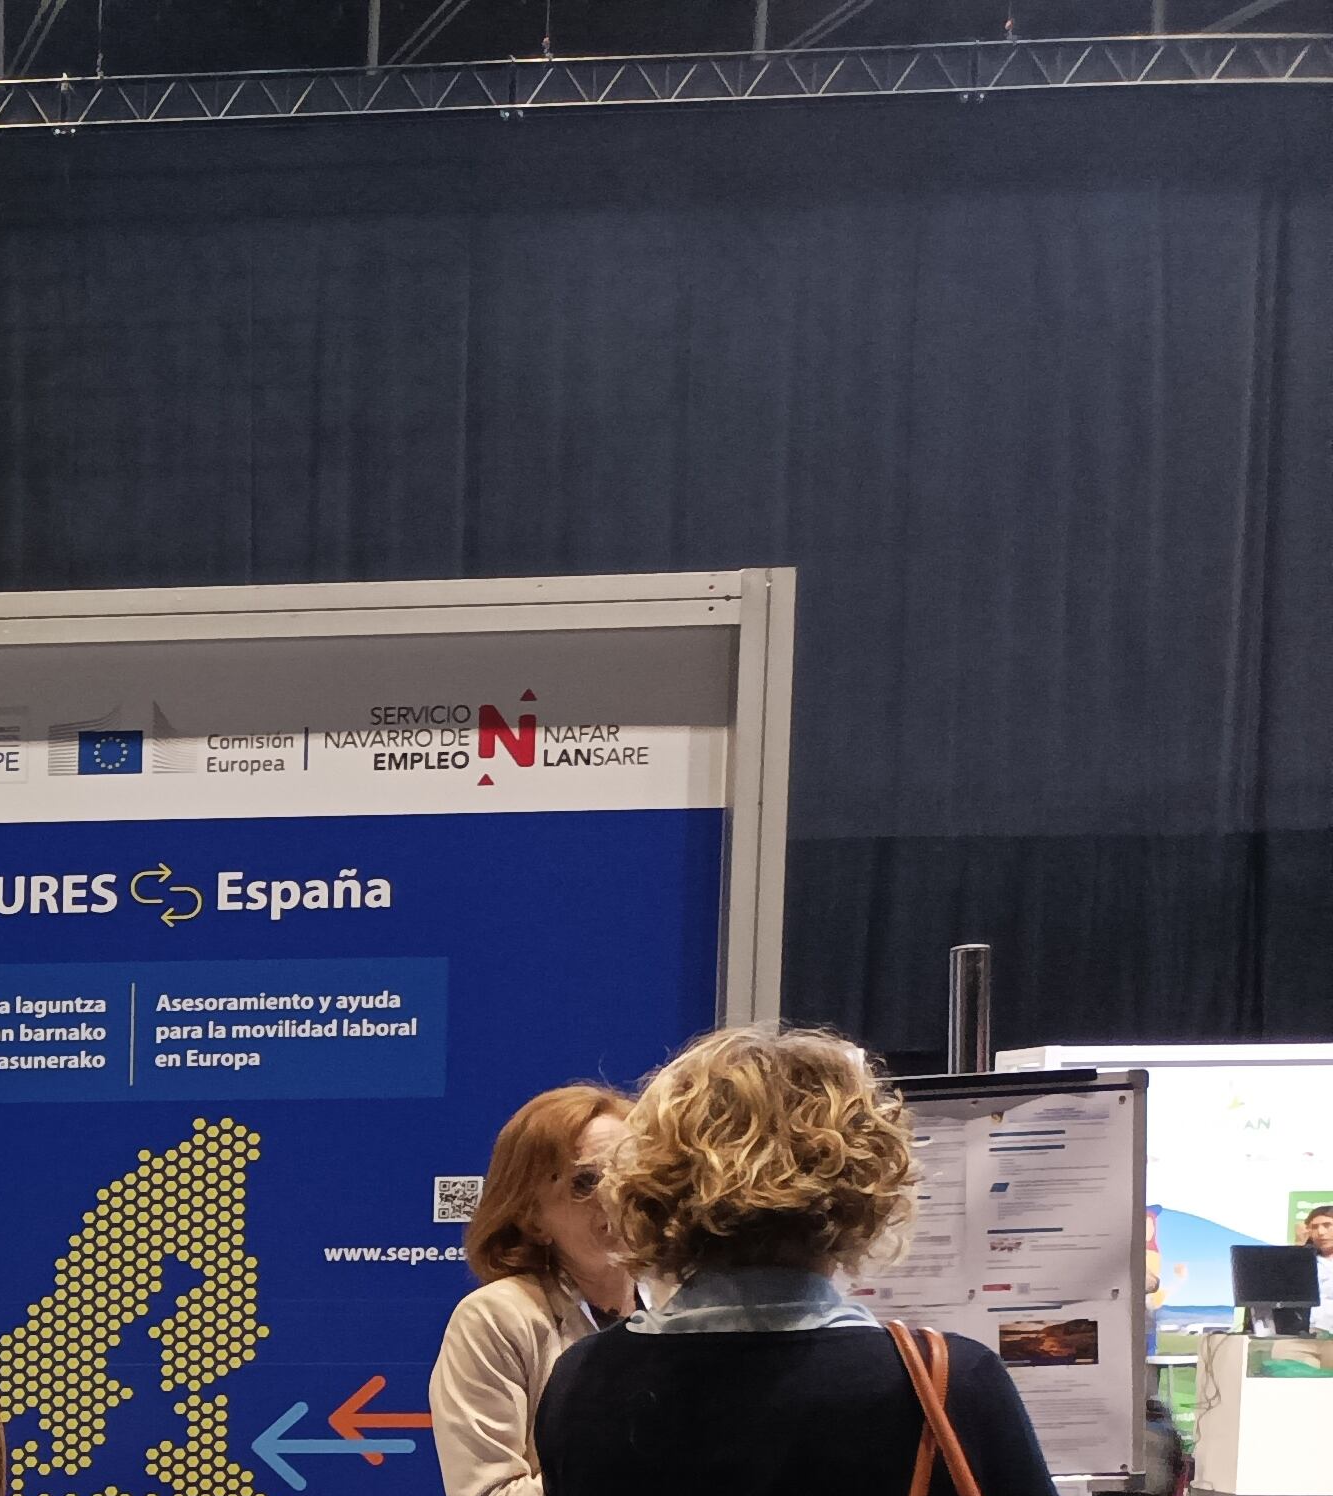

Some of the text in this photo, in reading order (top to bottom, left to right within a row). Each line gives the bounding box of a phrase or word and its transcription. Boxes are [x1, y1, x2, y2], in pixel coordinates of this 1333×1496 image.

[371, 705, 471, 725] SERVICIO
[207, 731, 294, 751] Comisión
[325, 728, 470, 749] NAVARRO DE
[544, 725, 619, 743] NAFAR
[207, 757, 284, 775] Europea
[374, 751, 469, 771] EMPLEO
[544, 746, 649, 767] LANSARE
[217, 869, 391, 920] España
[16, 996, 106, 1017] laguntza
[156, 990, 401, 1014] Asesoramiento y ayuda
[20, 1023, 106, 1041] barnako
[156, 1017, 417, 1043] para la movilidad laboral
[155, 1050, 260, 1070] en Europa
